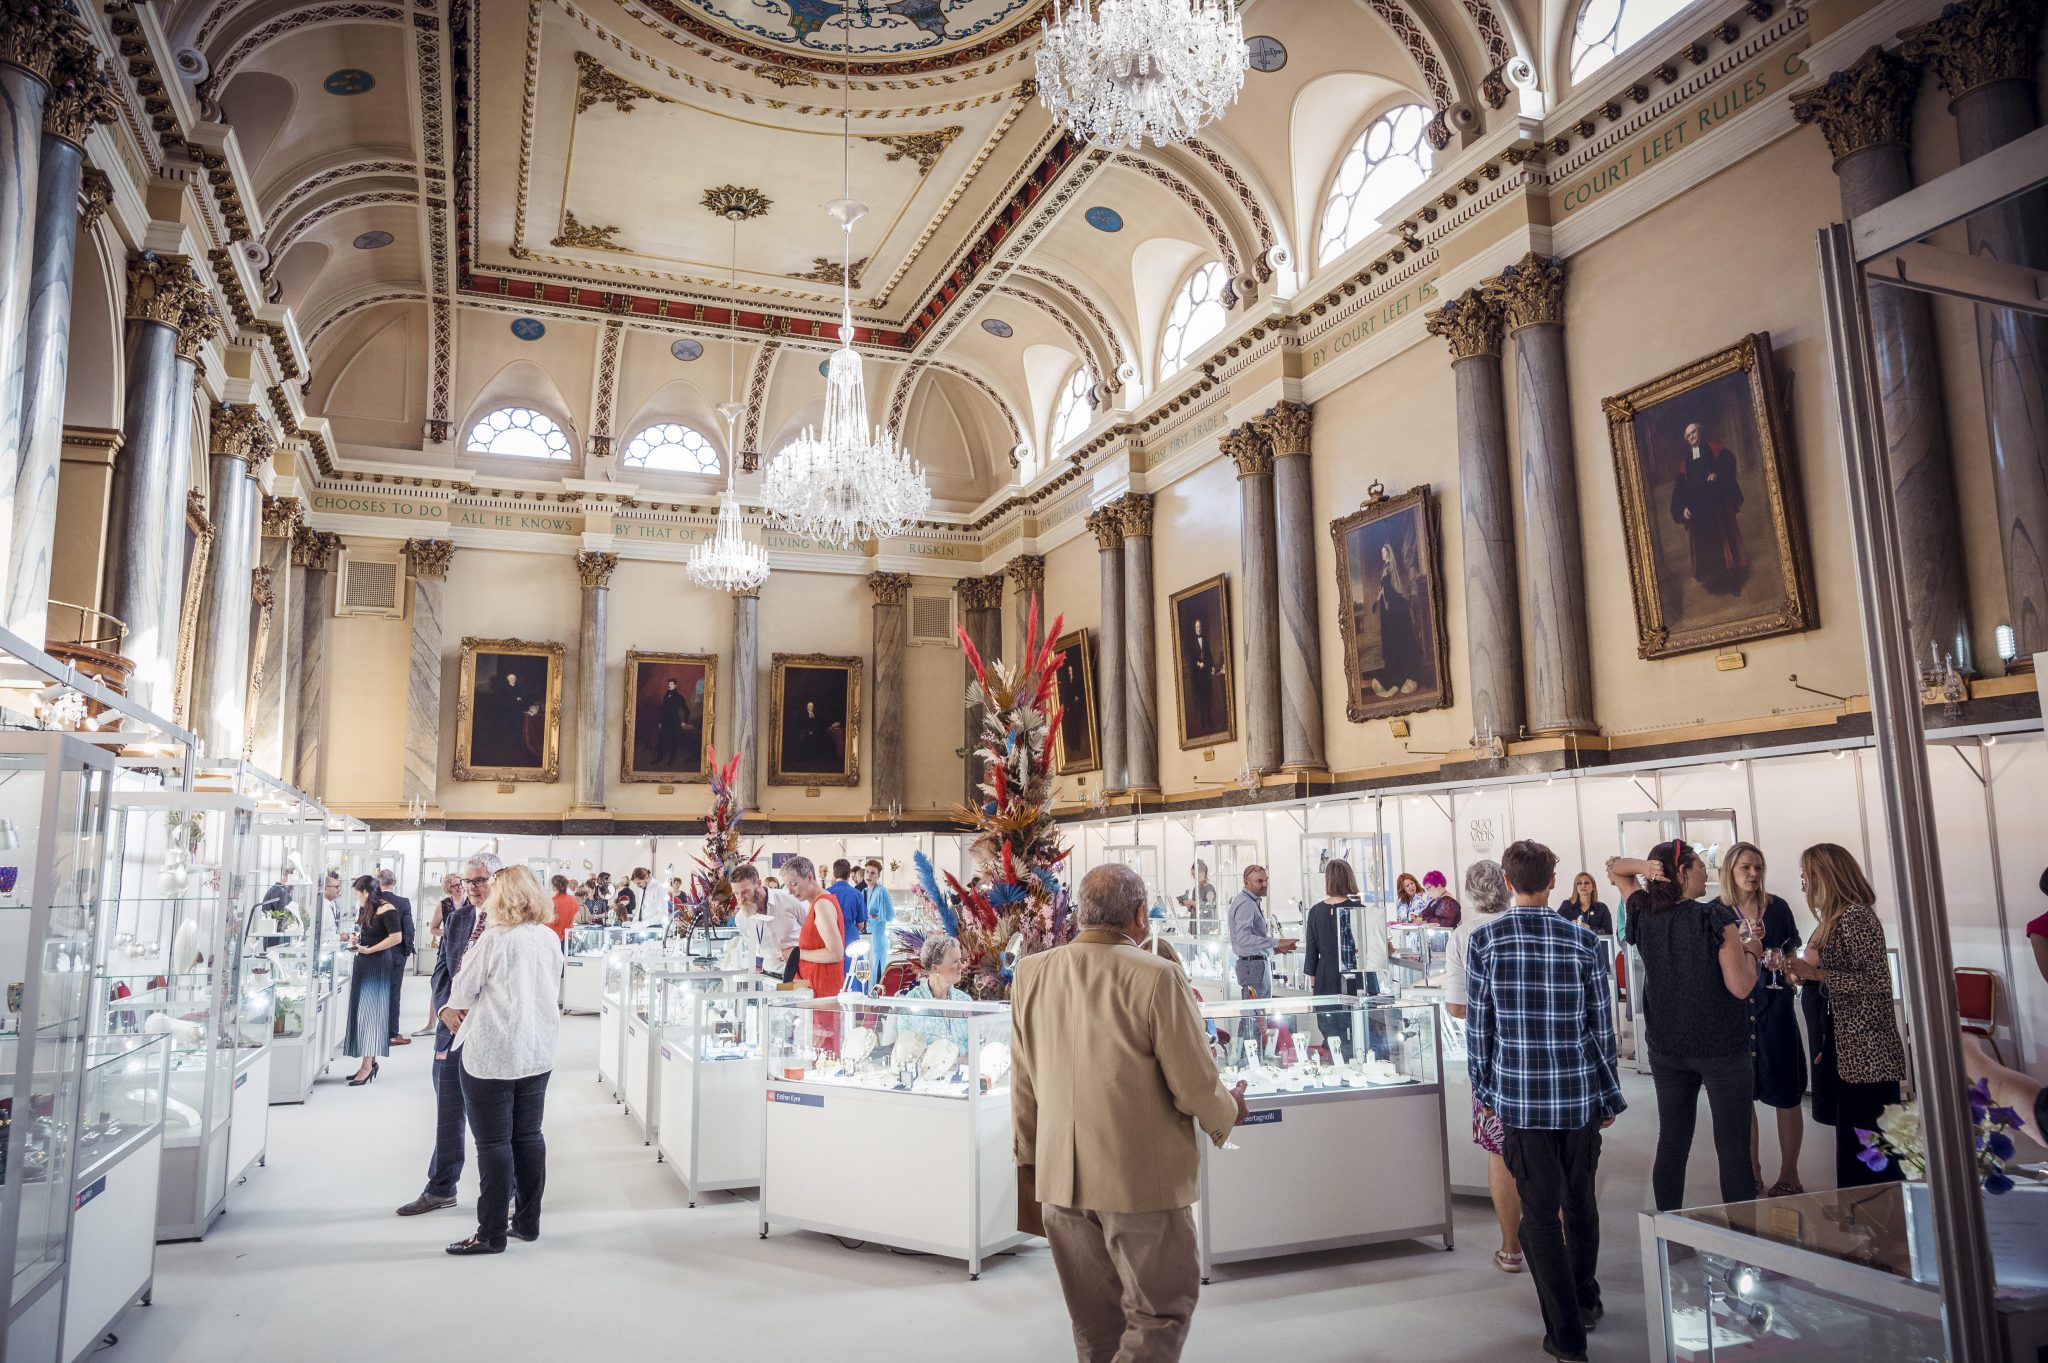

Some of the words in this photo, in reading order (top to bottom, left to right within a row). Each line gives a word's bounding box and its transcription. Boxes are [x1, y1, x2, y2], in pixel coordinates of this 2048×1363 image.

[1563, 155, 1632, 211] COURT
[1642, 122, 1688, 165] LEET
[1698, 73, 1767, 131] RULES
[1313, 345, 1328, 367] BY
[1334, 315, 1376, 353] COURT
[1383, 294, 1411, 324] LEET
[1193, 415, 1218, 439] TRADE
[314, 496, 386, 513] CHOOSES
[393, 502, 413, 515] TO
[419, 505, 442, 517] DO
[460, 513, 486, 525] ALL
[495, 515, 513, 527] HE
[521, 516, 572, 531] KNOWS
[615, 524, 631, 535] BY
[640, 526, 673, 539] THAT
[679, 528, 697, 540] OF
[768, 536, 810, 549] LIVING
